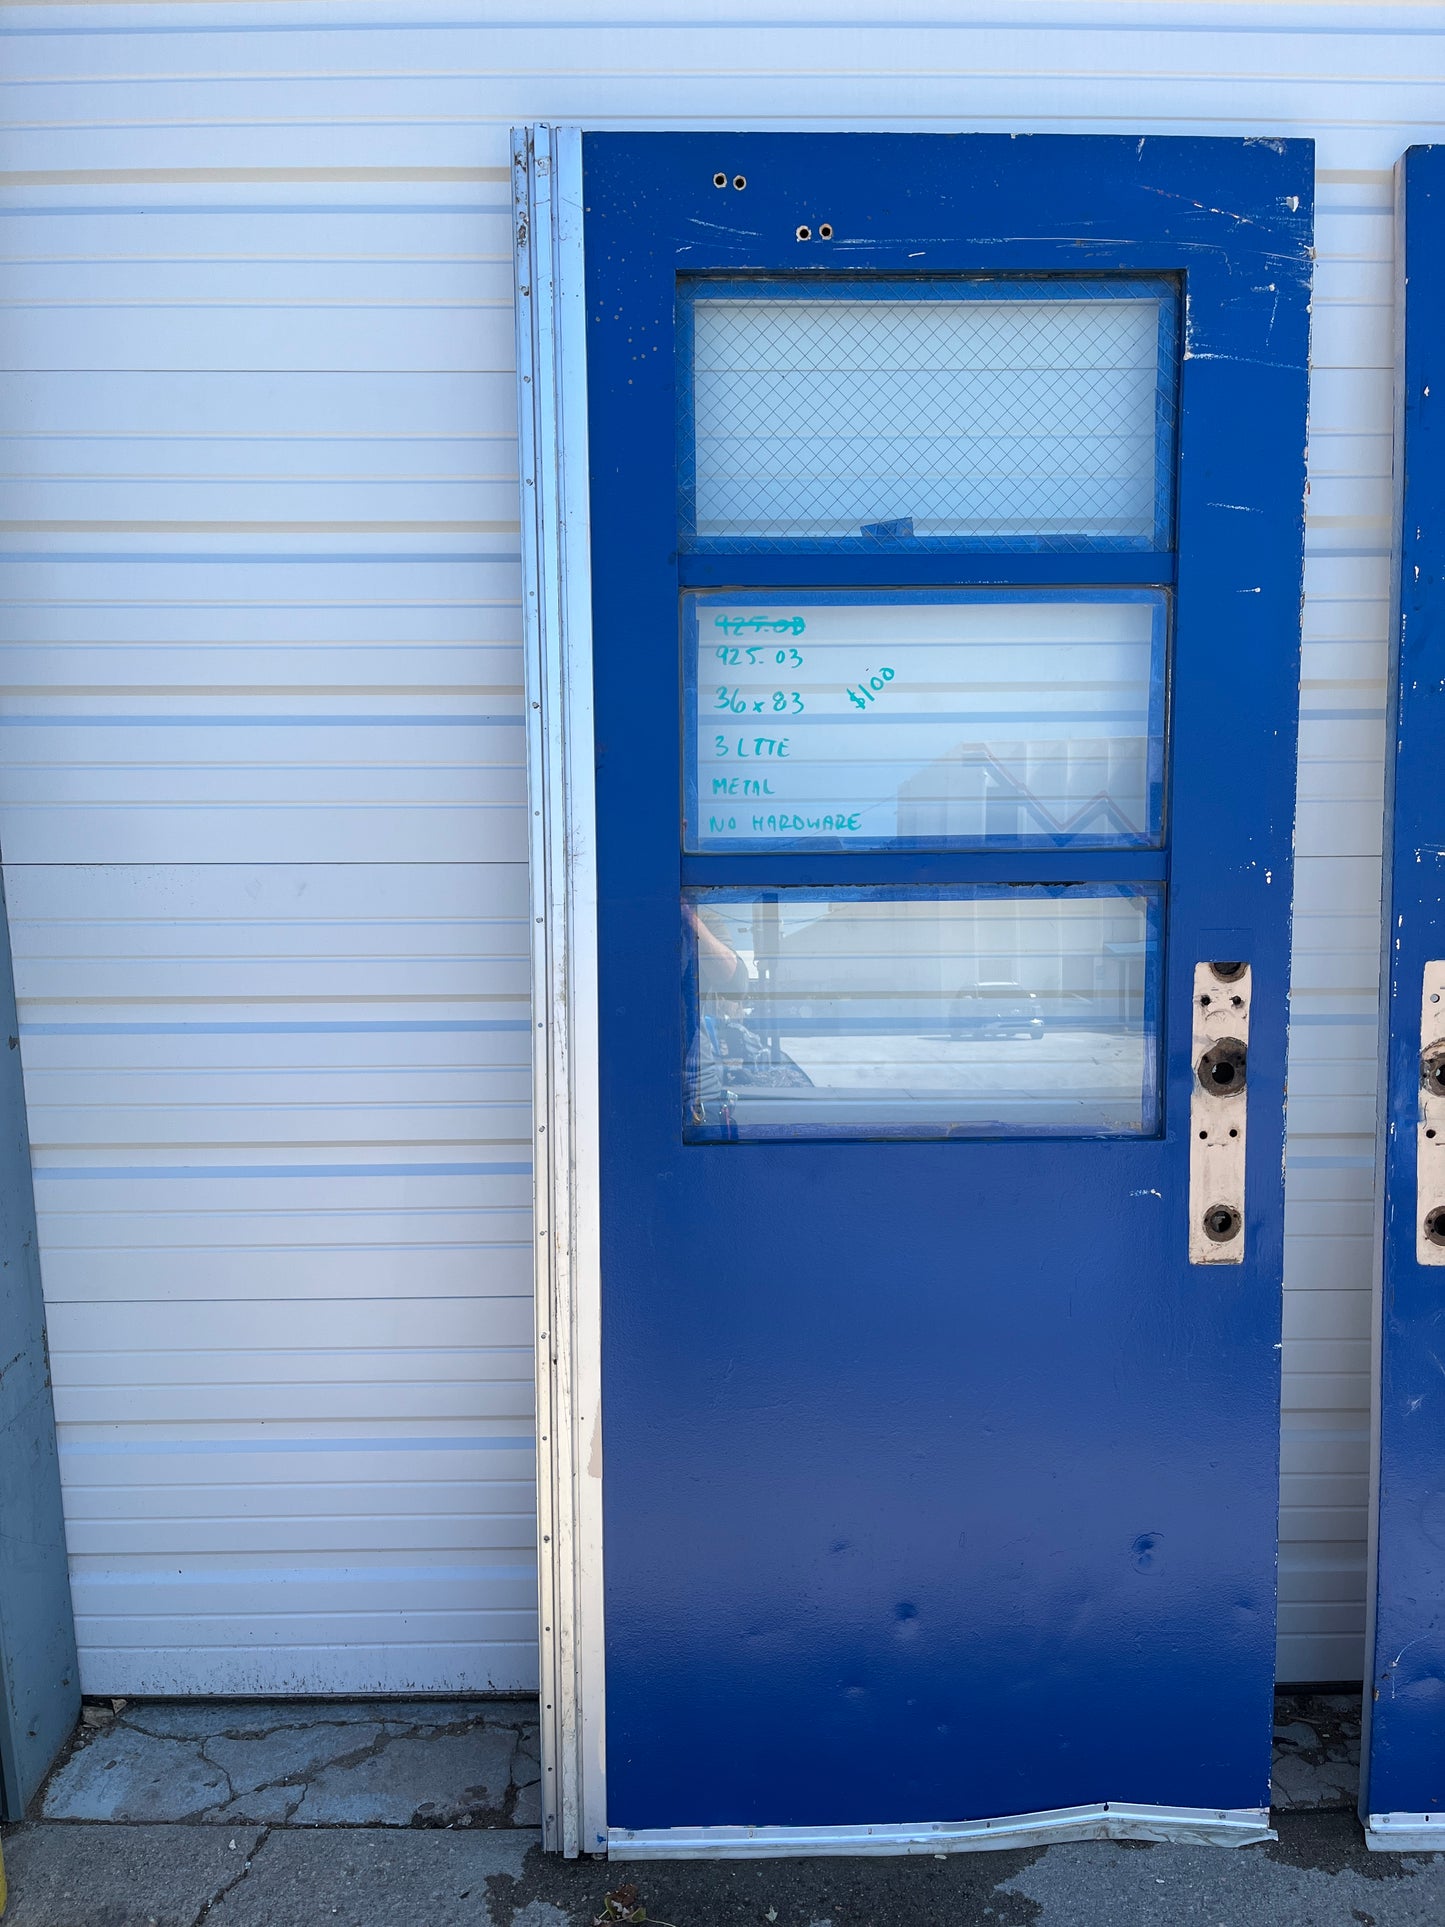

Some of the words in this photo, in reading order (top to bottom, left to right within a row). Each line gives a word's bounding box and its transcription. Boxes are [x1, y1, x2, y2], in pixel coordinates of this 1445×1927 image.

[846, 667, 895, 710] $100
[715, 735, 729, 757] 3
[712, 777, 775, 796] METAL
[709, 815, 737, 833] NO
[752, 812, 862, 832] HARDWARE
